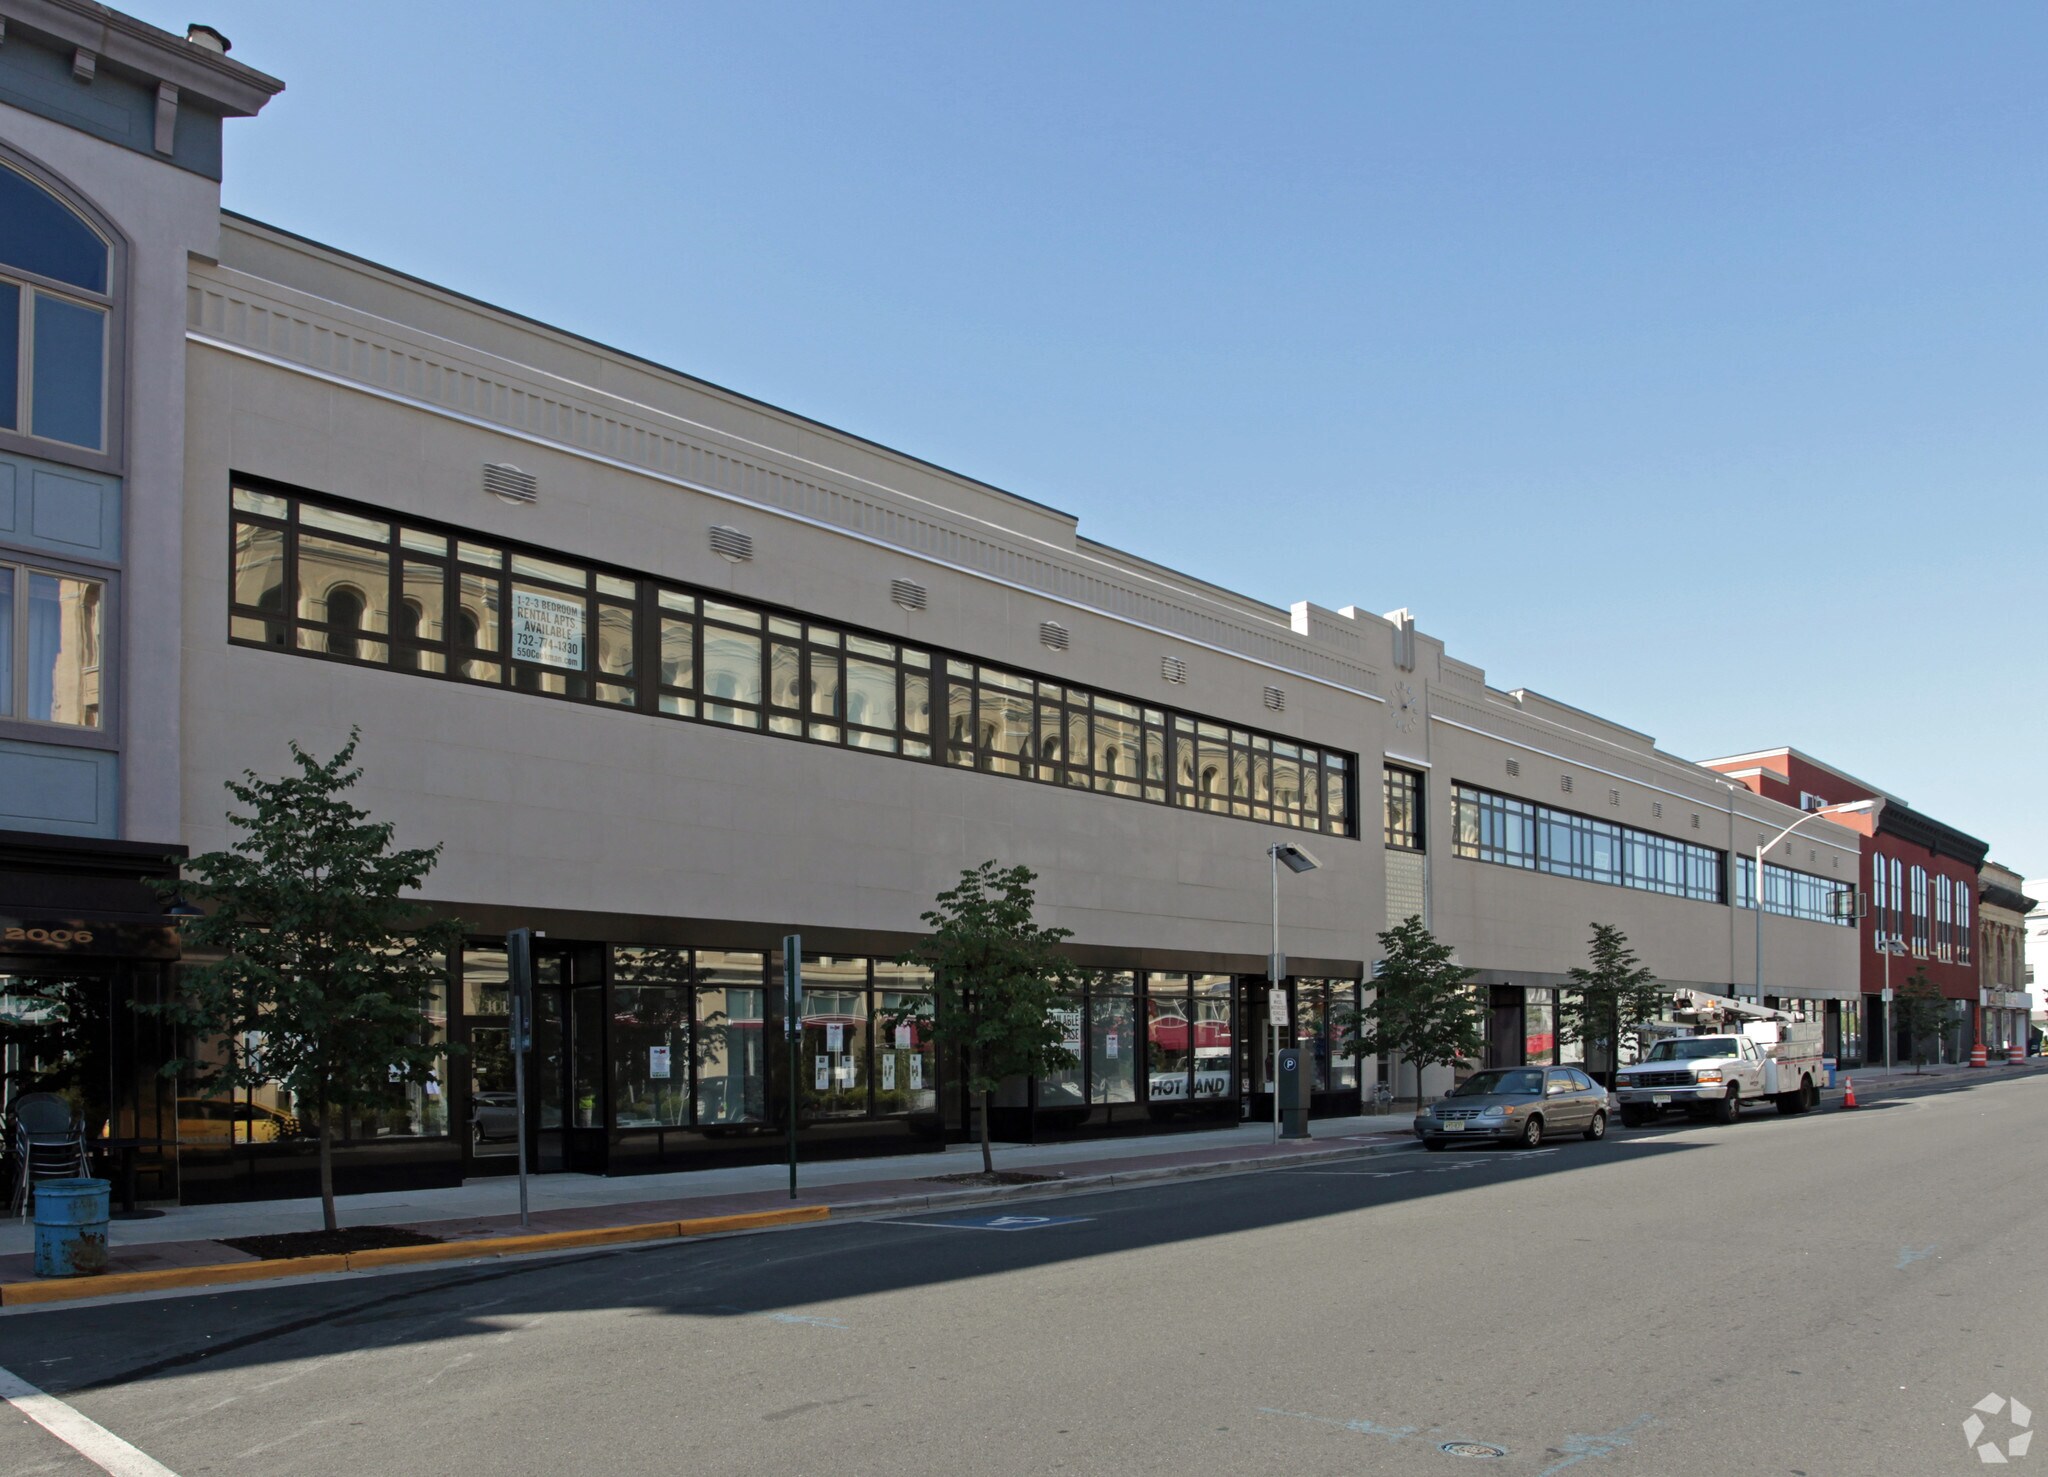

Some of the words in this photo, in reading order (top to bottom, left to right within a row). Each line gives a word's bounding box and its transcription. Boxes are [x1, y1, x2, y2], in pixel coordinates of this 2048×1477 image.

[518, 607, 551, 624] RENTAL
[541, 600, 578, 616] BEDROOM
[524, 621, 572, 640] AVAILABLE
[518, 633, 578, 654] 732-774-1330
[517, 647, 578, 666] 550Cooman.com
[4, 927, 94, 944] 2006
[1286, 1060, 1294, 1068] P
[1152, 1080, 1183, 1096] HOT
